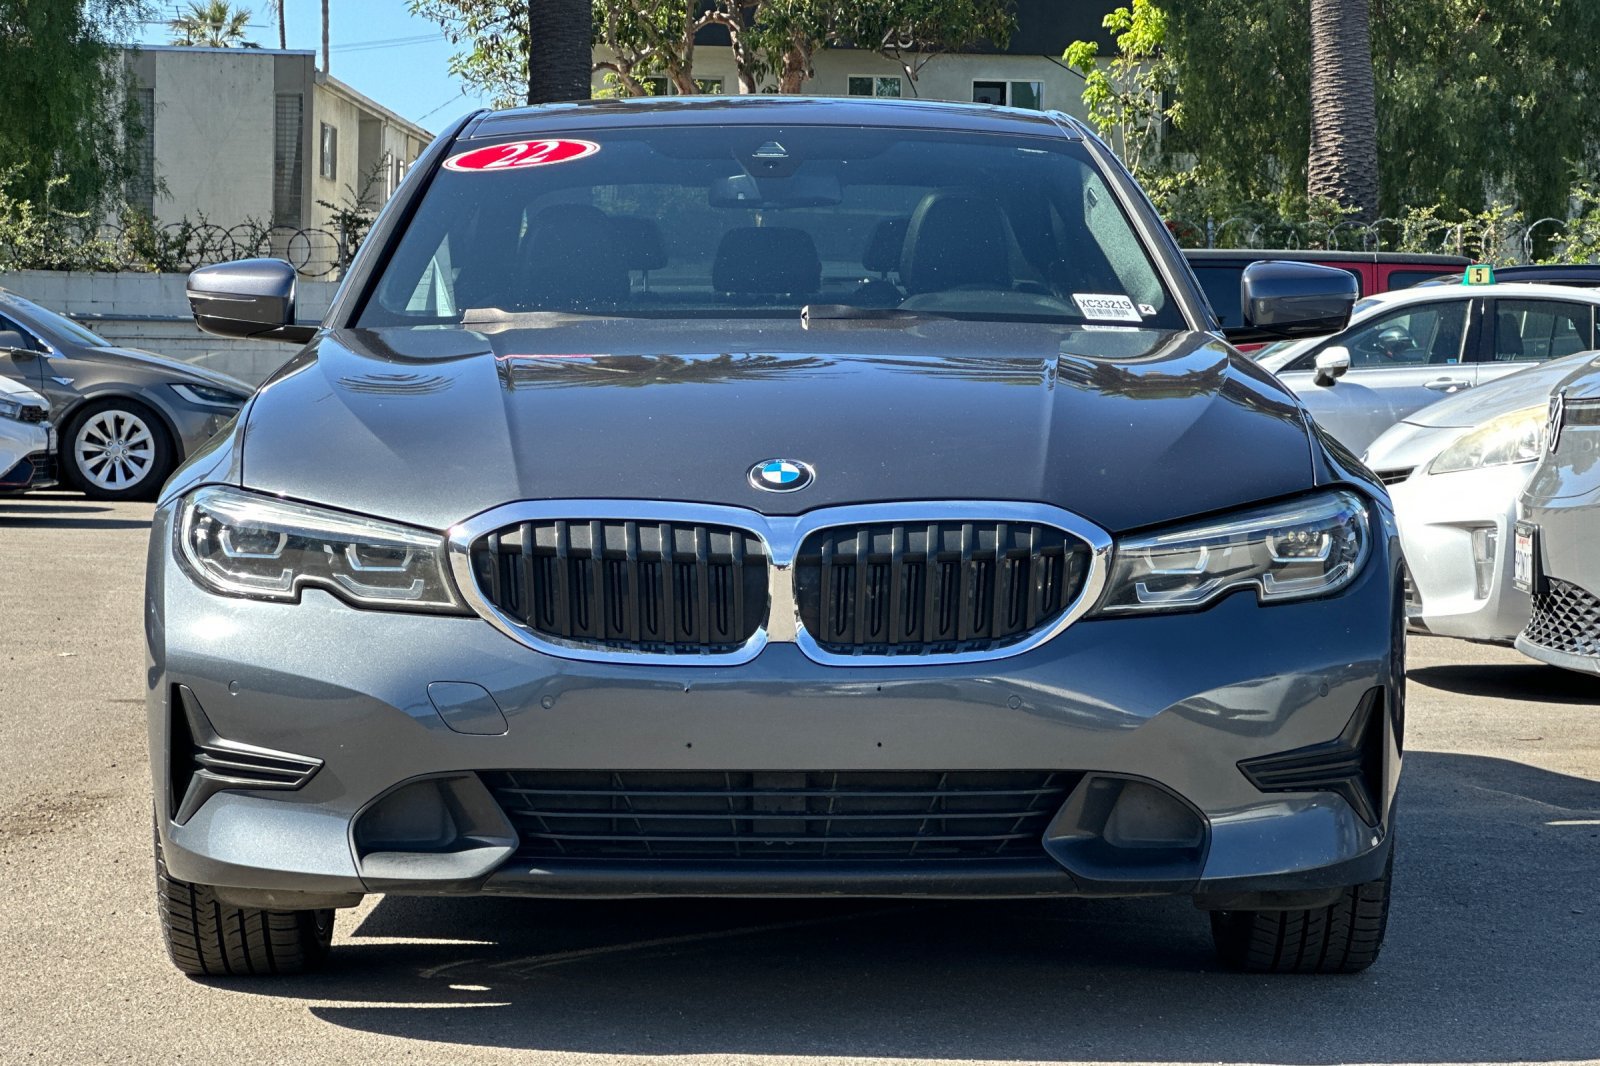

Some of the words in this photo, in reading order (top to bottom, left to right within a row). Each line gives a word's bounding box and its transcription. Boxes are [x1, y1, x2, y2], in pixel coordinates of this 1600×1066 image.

[483, 141, 560, 169] 22
[1475, 268, 1482, 283] 5
[1079, 299, 1132, 310] XC33219
